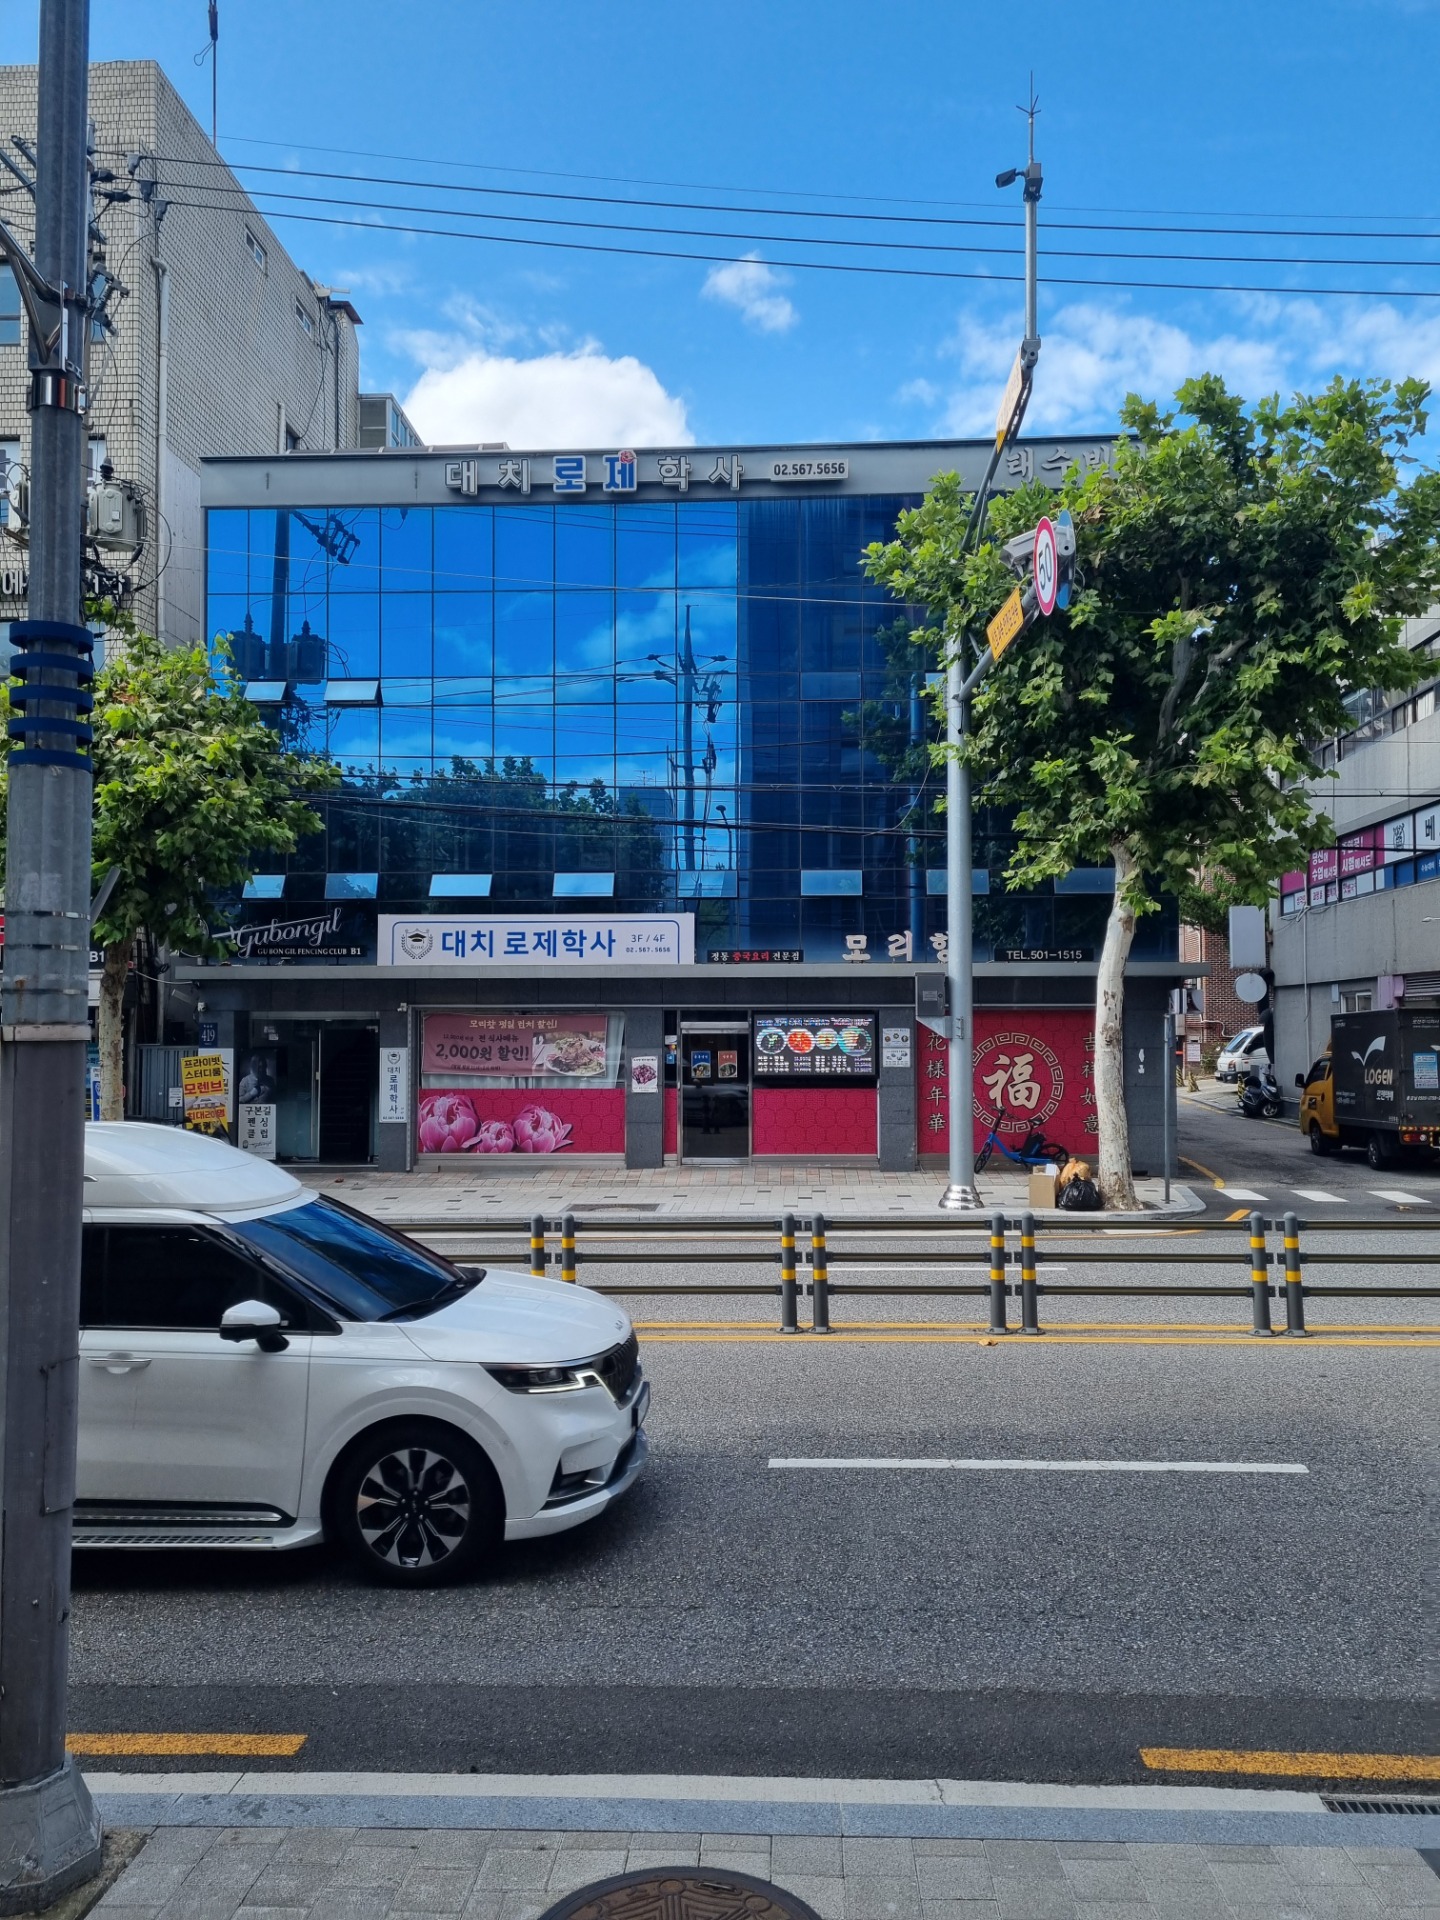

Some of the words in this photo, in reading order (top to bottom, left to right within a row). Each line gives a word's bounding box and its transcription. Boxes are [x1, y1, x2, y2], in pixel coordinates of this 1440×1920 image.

[773, 462, 846, 477] 02.567.5656
[1038, 542, 1053, 590] 50
[1342, 855, 1371, 872] 시험에서도
[442, 930, 493, 958] 대치
[503, 929, 616, 958] 로제학사
[631, 934, 643, 943] 3F
[653, 934, 666, 943] 4F
[90, 951, 105, 962] B1
[297, 948, 328, 956] FENCING
[329, 948, 347, 956] CLUB
[350, 947, 361, 955] B1
[711, 952, 729, 962] 정통
[732, 952, 770, 962] 중국요리
[772, 952, 800, 962] 전문점
[1006, 950, 1083, 960] TEL.501-1515
[201, 1029, 216, 1042] 419
[488, 1033, 519, 1043] 식사메뉴
[435, 1043, 492, 1061] 2,000원
[497, 1045, 529, 1062] 할인!
[184, 1057, 221, 1069] 프라이빗
[185, 1067, 222, 1080] 스터디룸
[387, 1066, 401, 1074] 대치
[982, 1053, 1041, 1109] 福
[1364, 1069, 1393, 1085] LOGEN
[184, 1081, 223, 1096] 모렌브
[389, 1074, 399, 1114] 로제학사
[244, 1106, 271, 1116] 구본길
[247, 1117, 269, 1127] 펜싱
